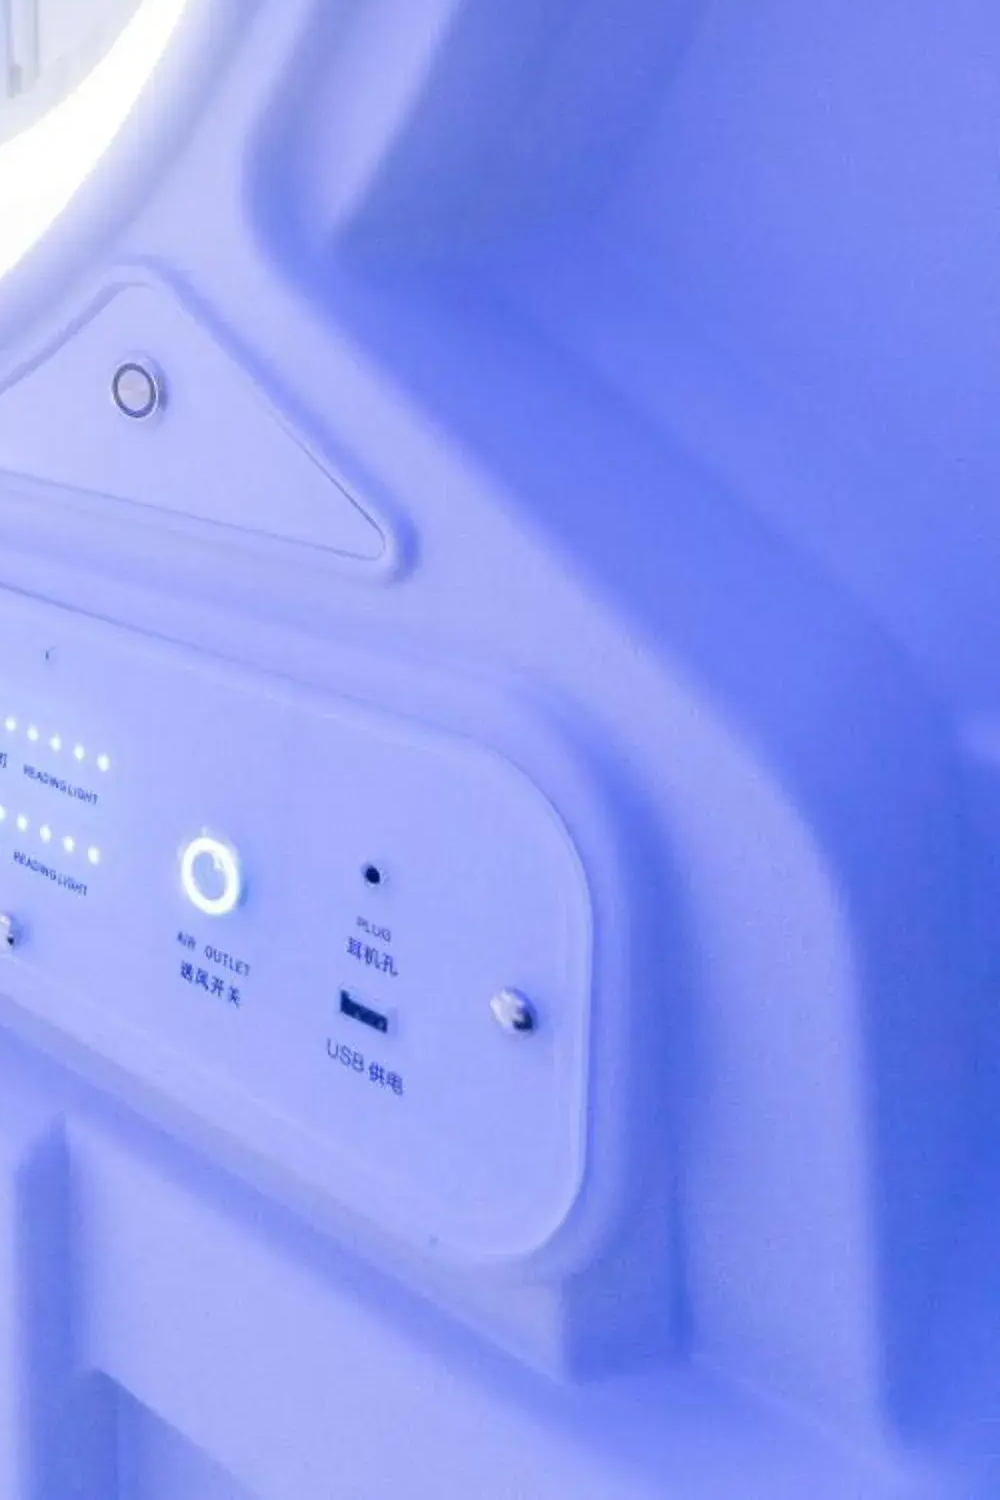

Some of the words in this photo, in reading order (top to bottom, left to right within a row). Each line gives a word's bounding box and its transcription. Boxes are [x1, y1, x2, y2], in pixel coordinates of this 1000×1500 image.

[356, 915, 391, 942] PLUG
[177, 931, 196, 951] AIR
[205, 945, 251, 977] OUTLET
[346, 936, 398, 977] 耳机孔
[180, 961, 241, 1008] 送风开关
[327, 1037, 364, 1073] USB
[368, 1061, 404, 1096] 供电
